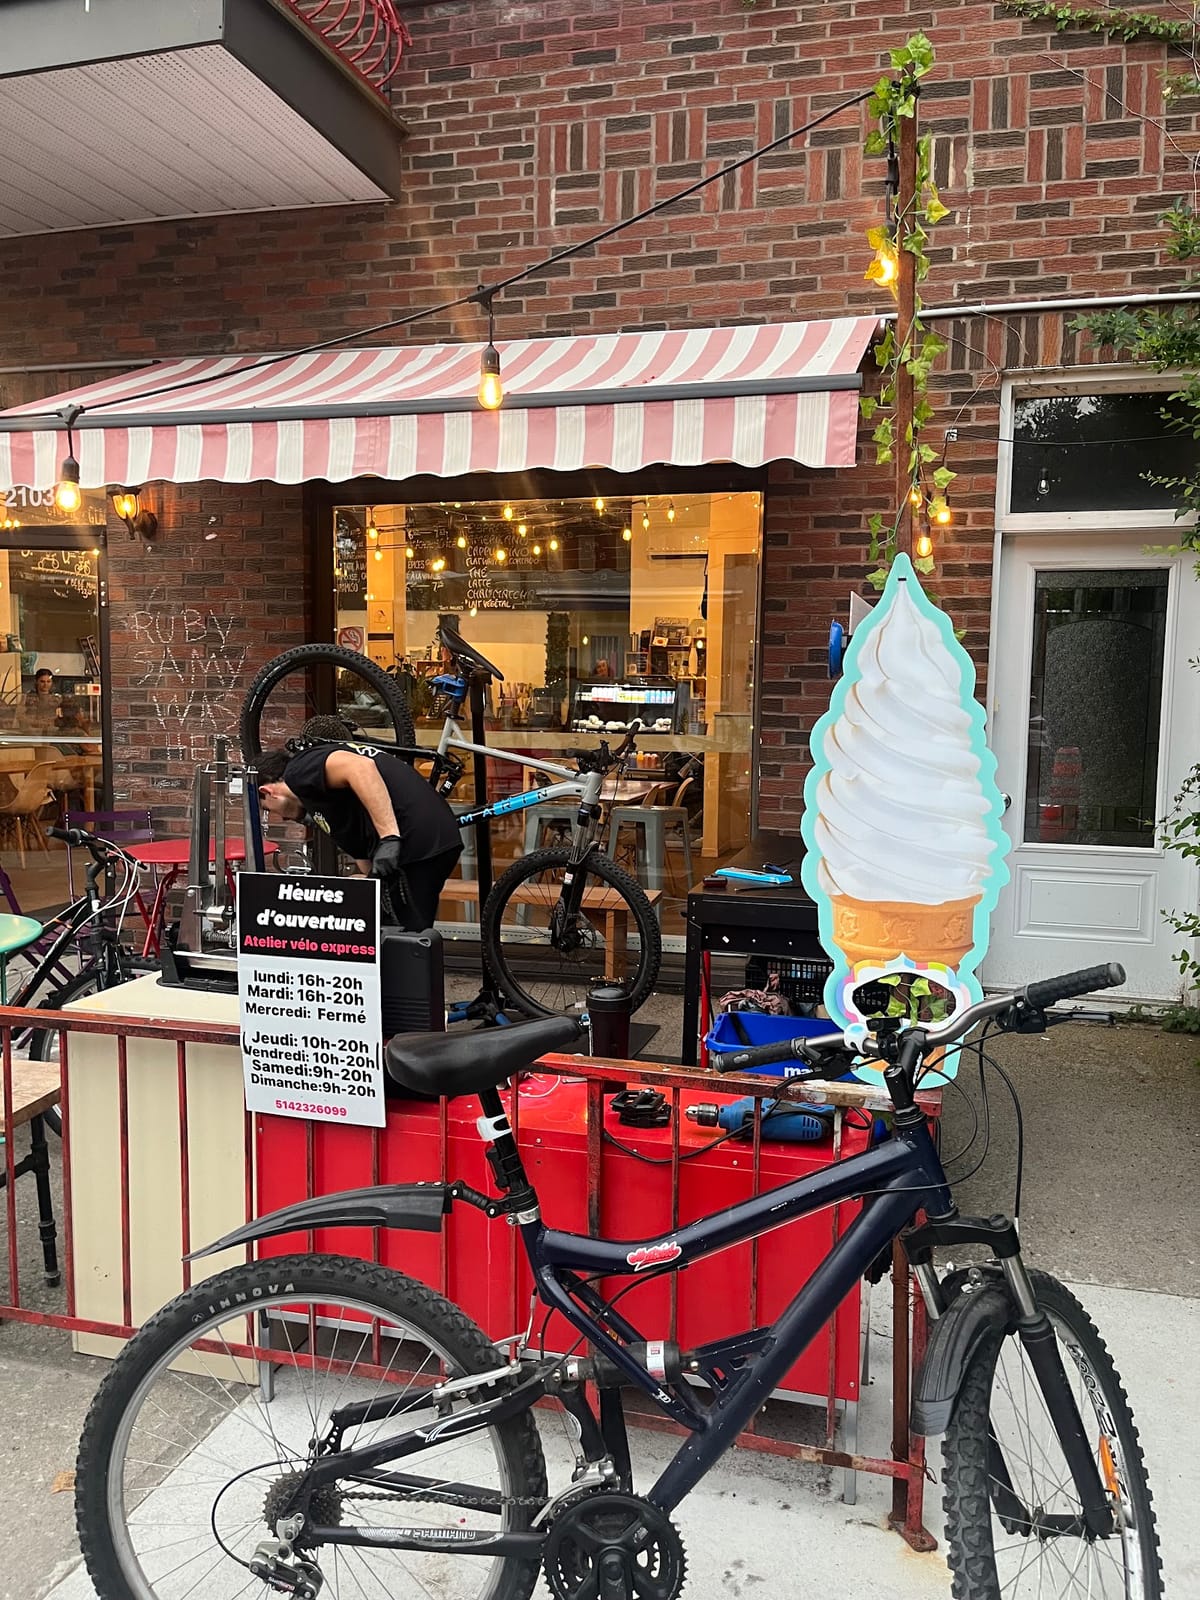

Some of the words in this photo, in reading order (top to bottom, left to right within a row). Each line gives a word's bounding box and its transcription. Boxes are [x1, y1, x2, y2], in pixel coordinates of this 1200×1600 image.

[6, 487, 55, 507] 2103
[468, 579, 492, 588] LATTE
[131, 609, 235, 651] RUBY
[134, 642, 253, 691] SAMY
[460, 790, 547, 824] MARIN
[278, 883, 344, 904] Heures
[256, 909, 366, 932] d'ouverture
[243, 934, 288, 950] Atelier
[289, 937, 318, 952] vélo
[320, 941, 376, 956] express
[253, 970, 294, 985] lundi:
[297, 973, 363, 991] 16h-20h
[247, 985, 294, 1000] Mardi:
[297, 989, 364, 1007] 16h-20h
[245, 1002, 311, 1019] Mercredi:
[317, 1008, 366, 1024] Fermé
[251, 1031, 298, 1047] Jeudi:
[301, 1036, 369, 1054] 10h-20h
[244, 1046, 310, 1063] Vendredi:
[312, 1051, 375, 1069] 10h-20h
[275, 1100, 347, 1117] 5142326099
[208, 1283, 295, 1314] INNOVA
